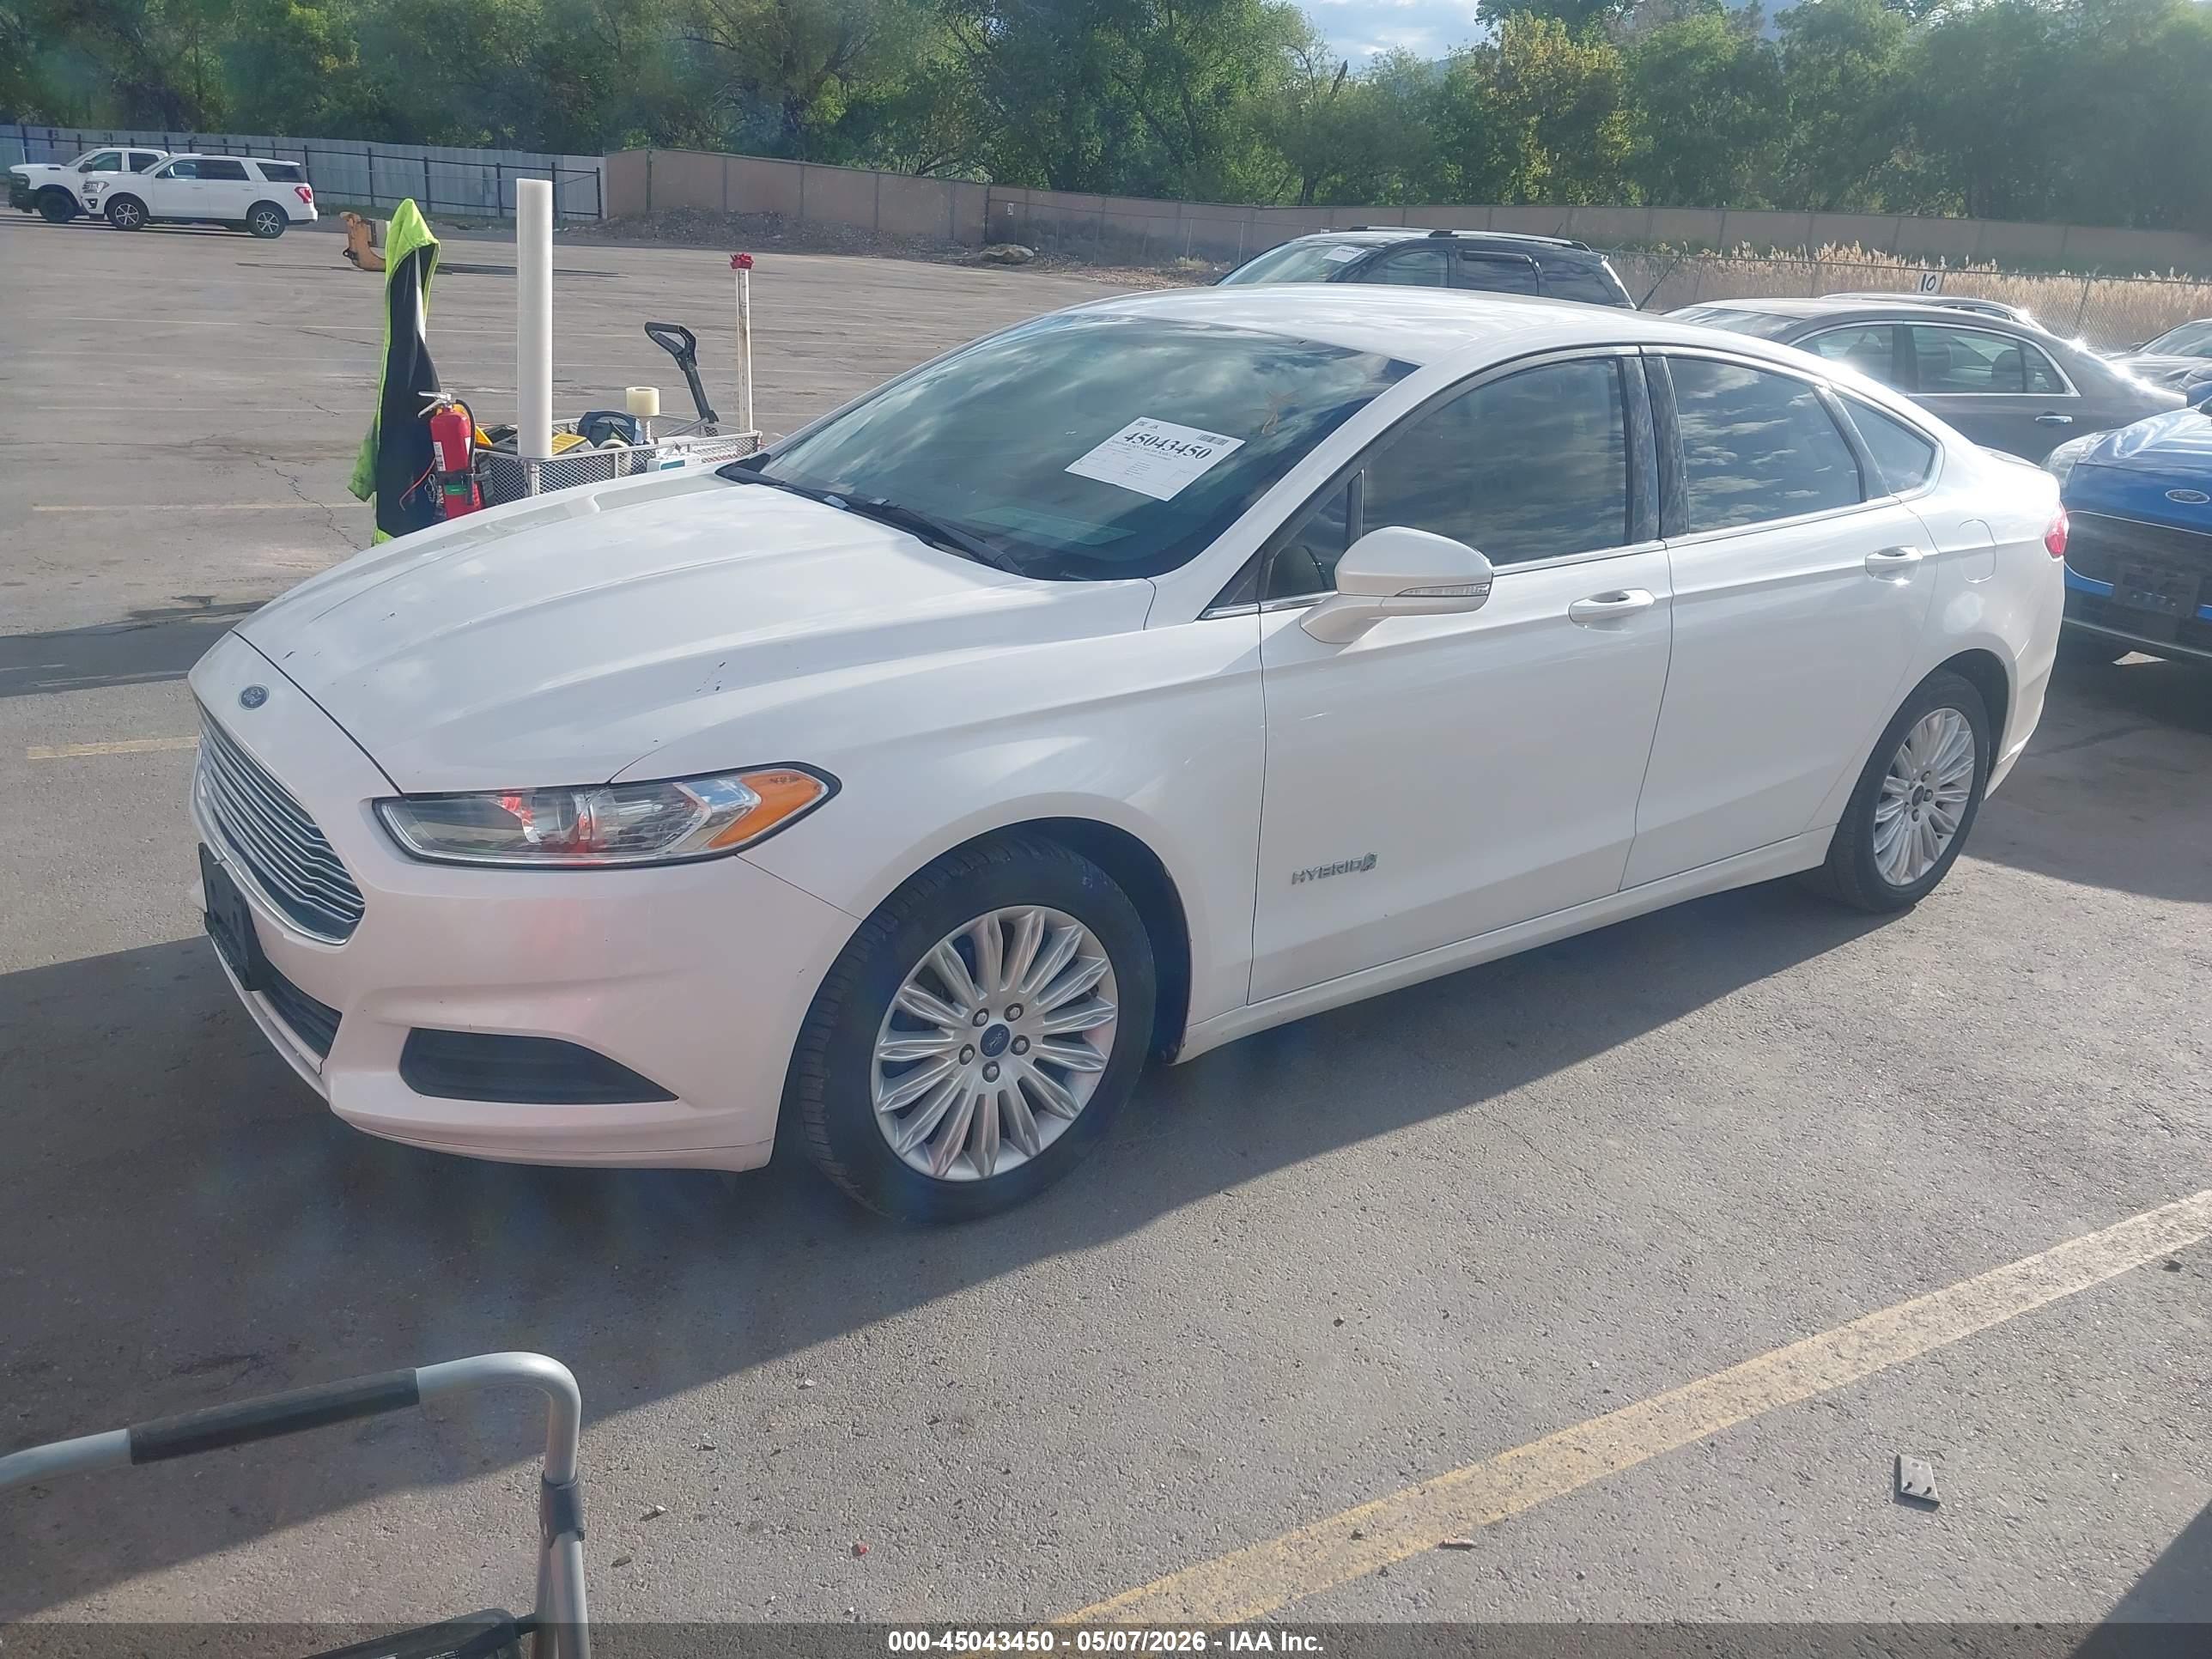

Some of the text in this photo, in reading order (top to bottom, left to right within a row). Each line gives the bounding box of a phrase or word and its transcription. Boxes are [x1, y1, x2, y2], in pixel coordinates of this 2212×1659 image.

[1921, 273, 1937, 292] 10
[1124, 432, 1212, 459] 45043450
[1291, 858, 1363, 885] HYBRID
